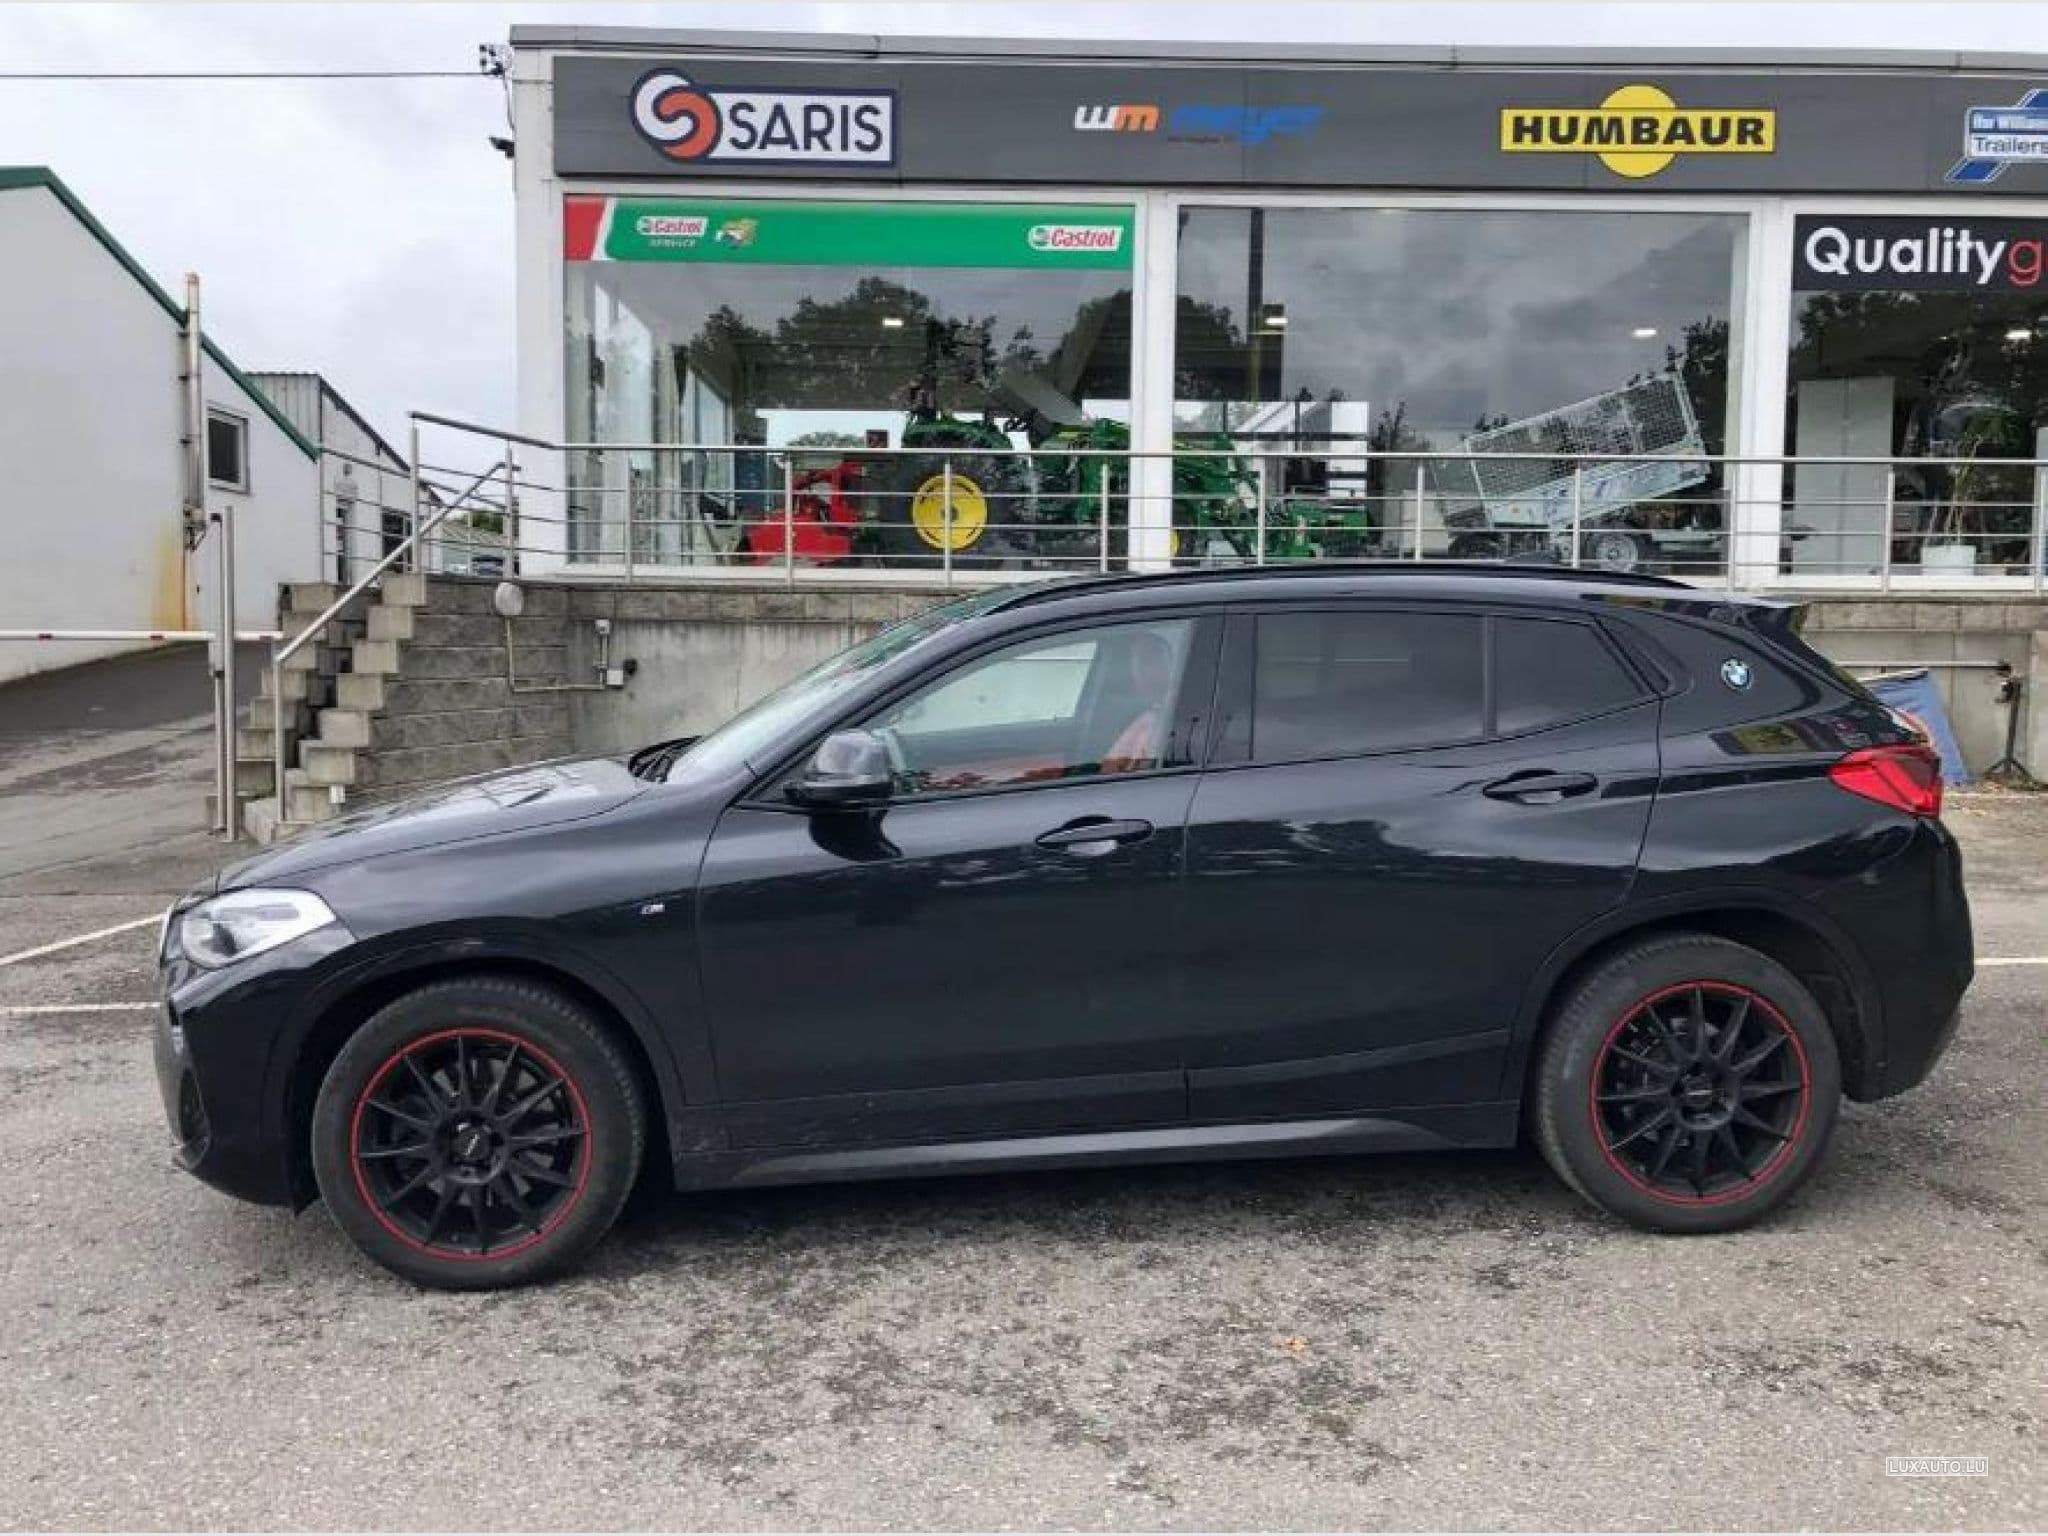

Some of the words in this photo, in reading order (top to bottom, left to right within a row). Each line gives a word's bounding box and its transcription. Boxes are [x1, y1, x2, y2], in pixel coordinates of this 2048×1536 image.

[728, 101, 884, 154] SARIS
[1511, 115, 1767, 146] HUMBAUR
[1051, 228, 1116, 247] Castrol
